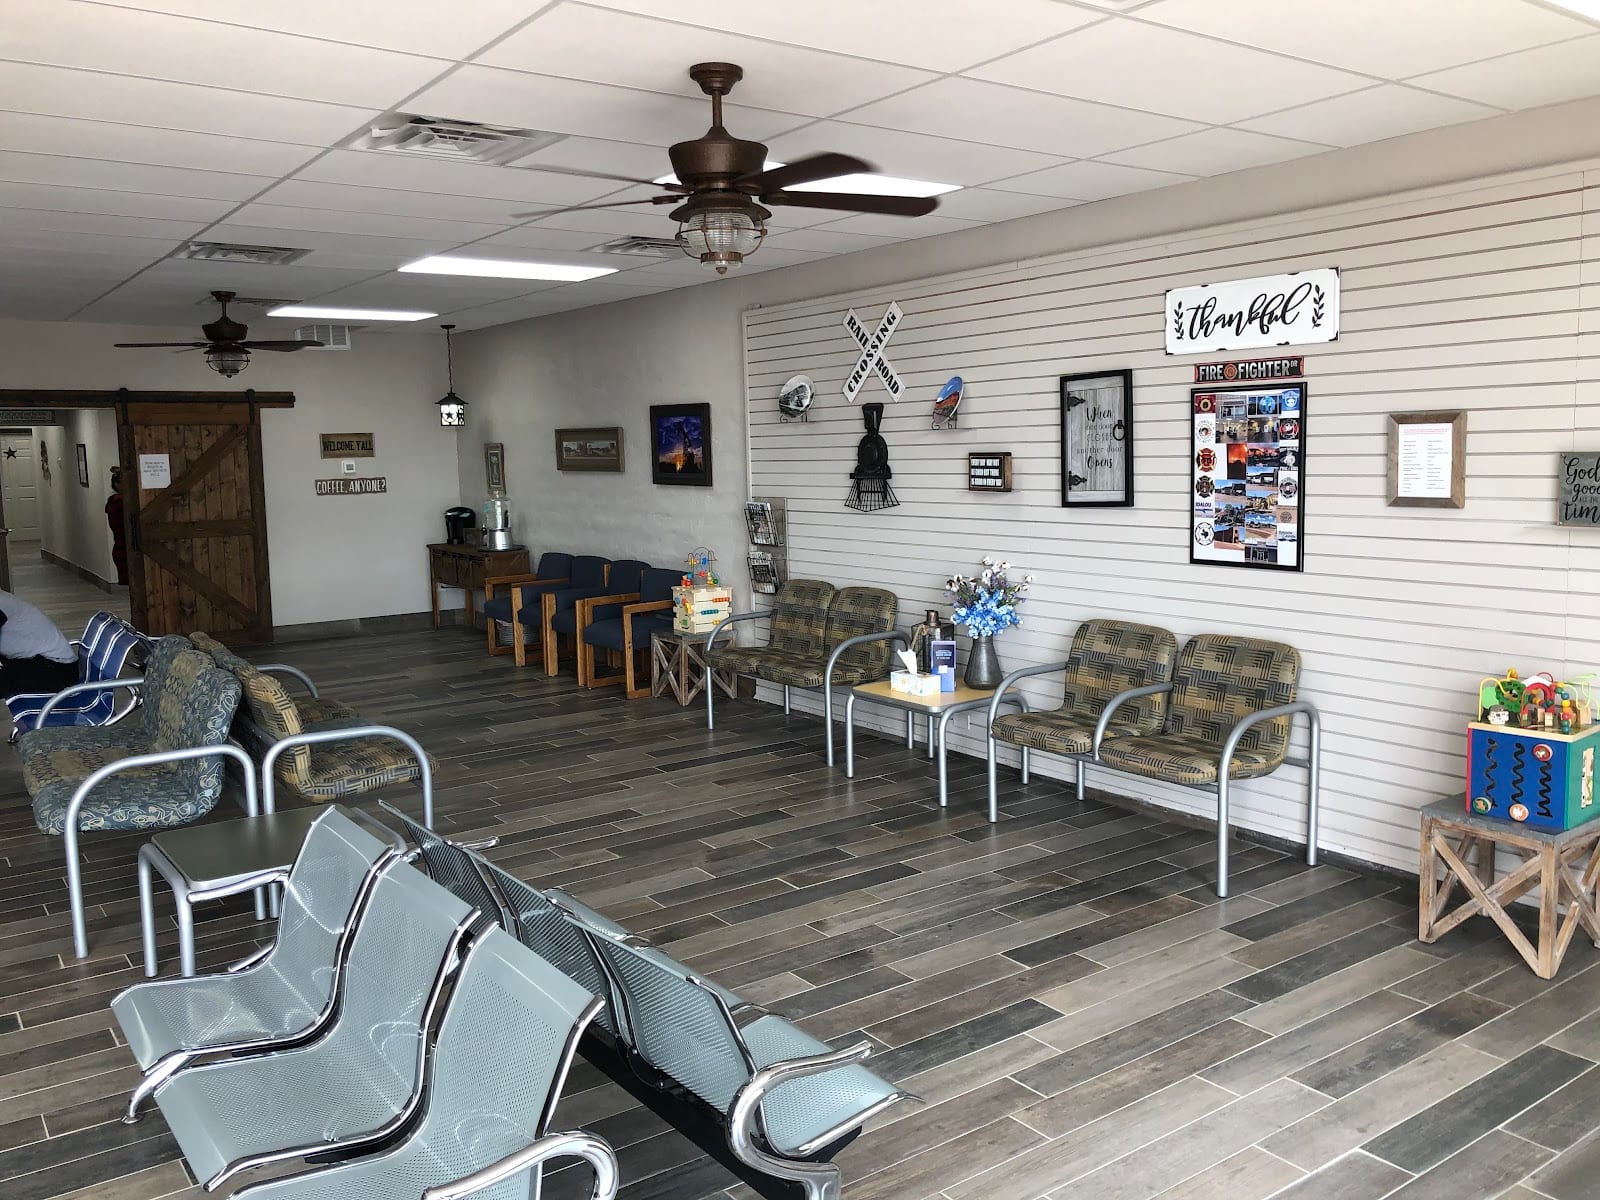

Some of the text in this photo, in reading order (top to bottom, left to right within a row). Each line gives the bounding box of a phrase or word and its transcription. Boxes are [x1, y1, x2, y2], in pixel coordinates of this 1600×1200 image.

[1186, 282, 1312, 340] thankful
[847, 311, 896, 393] CROSSING
[847, 315, 899, 394] RAIL ROAD
[1199, 363, 1224, 381] FIRE
[1238, 360, 1290, 379] FIGHTER
[1086, 406, 1112, 422] When
[323, 440, 355, 452] WELCOME
[1563, 455, 1600, 485] God
[349, 479, 386, 492] ANYONE?
[1562, 501, 1600, 523] tim
